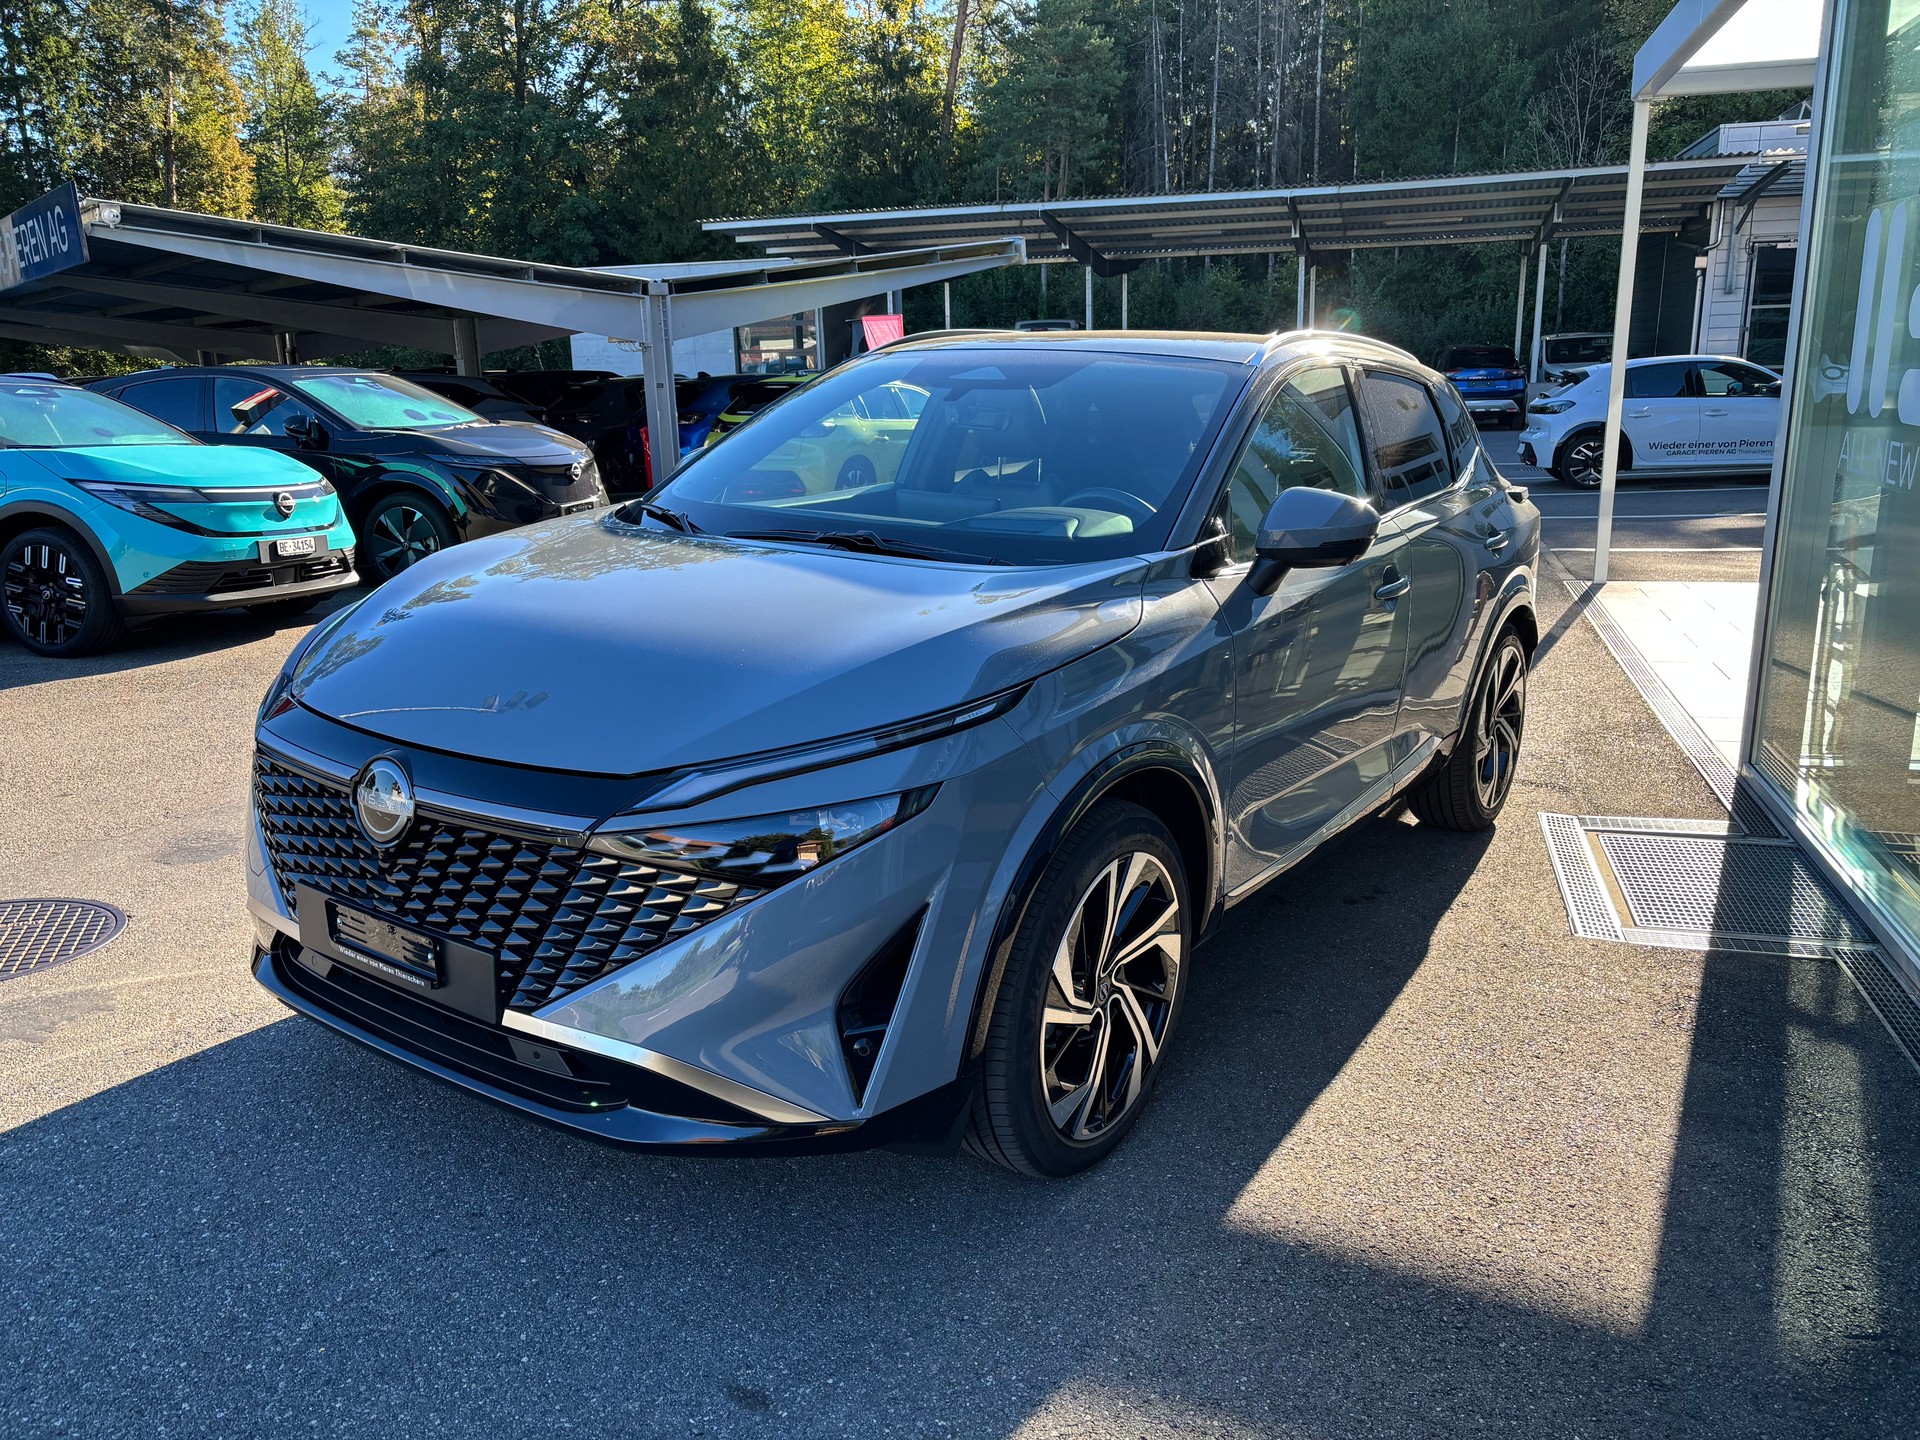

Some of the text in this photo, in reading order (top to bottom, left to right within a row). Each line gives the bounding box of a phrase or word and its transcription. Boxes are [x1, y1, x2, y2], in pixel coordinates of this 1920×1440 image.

[4, 215, 49, 269] PIEREN
[47, 205, 68, 256] AG
[1648, 441, 1687, 450] Wieder
[1688, 440, 1716, 449] einer
[1739, 439, 1773, 448] Pieren
[1698, 448, 1725, 456] PIEREN
[357, 786, 413, 814] NISSAN
[338, 945, 356, 959] Wieder
[369, 960, 379, 968] von
[379, 962, 395, 975] Pieren
